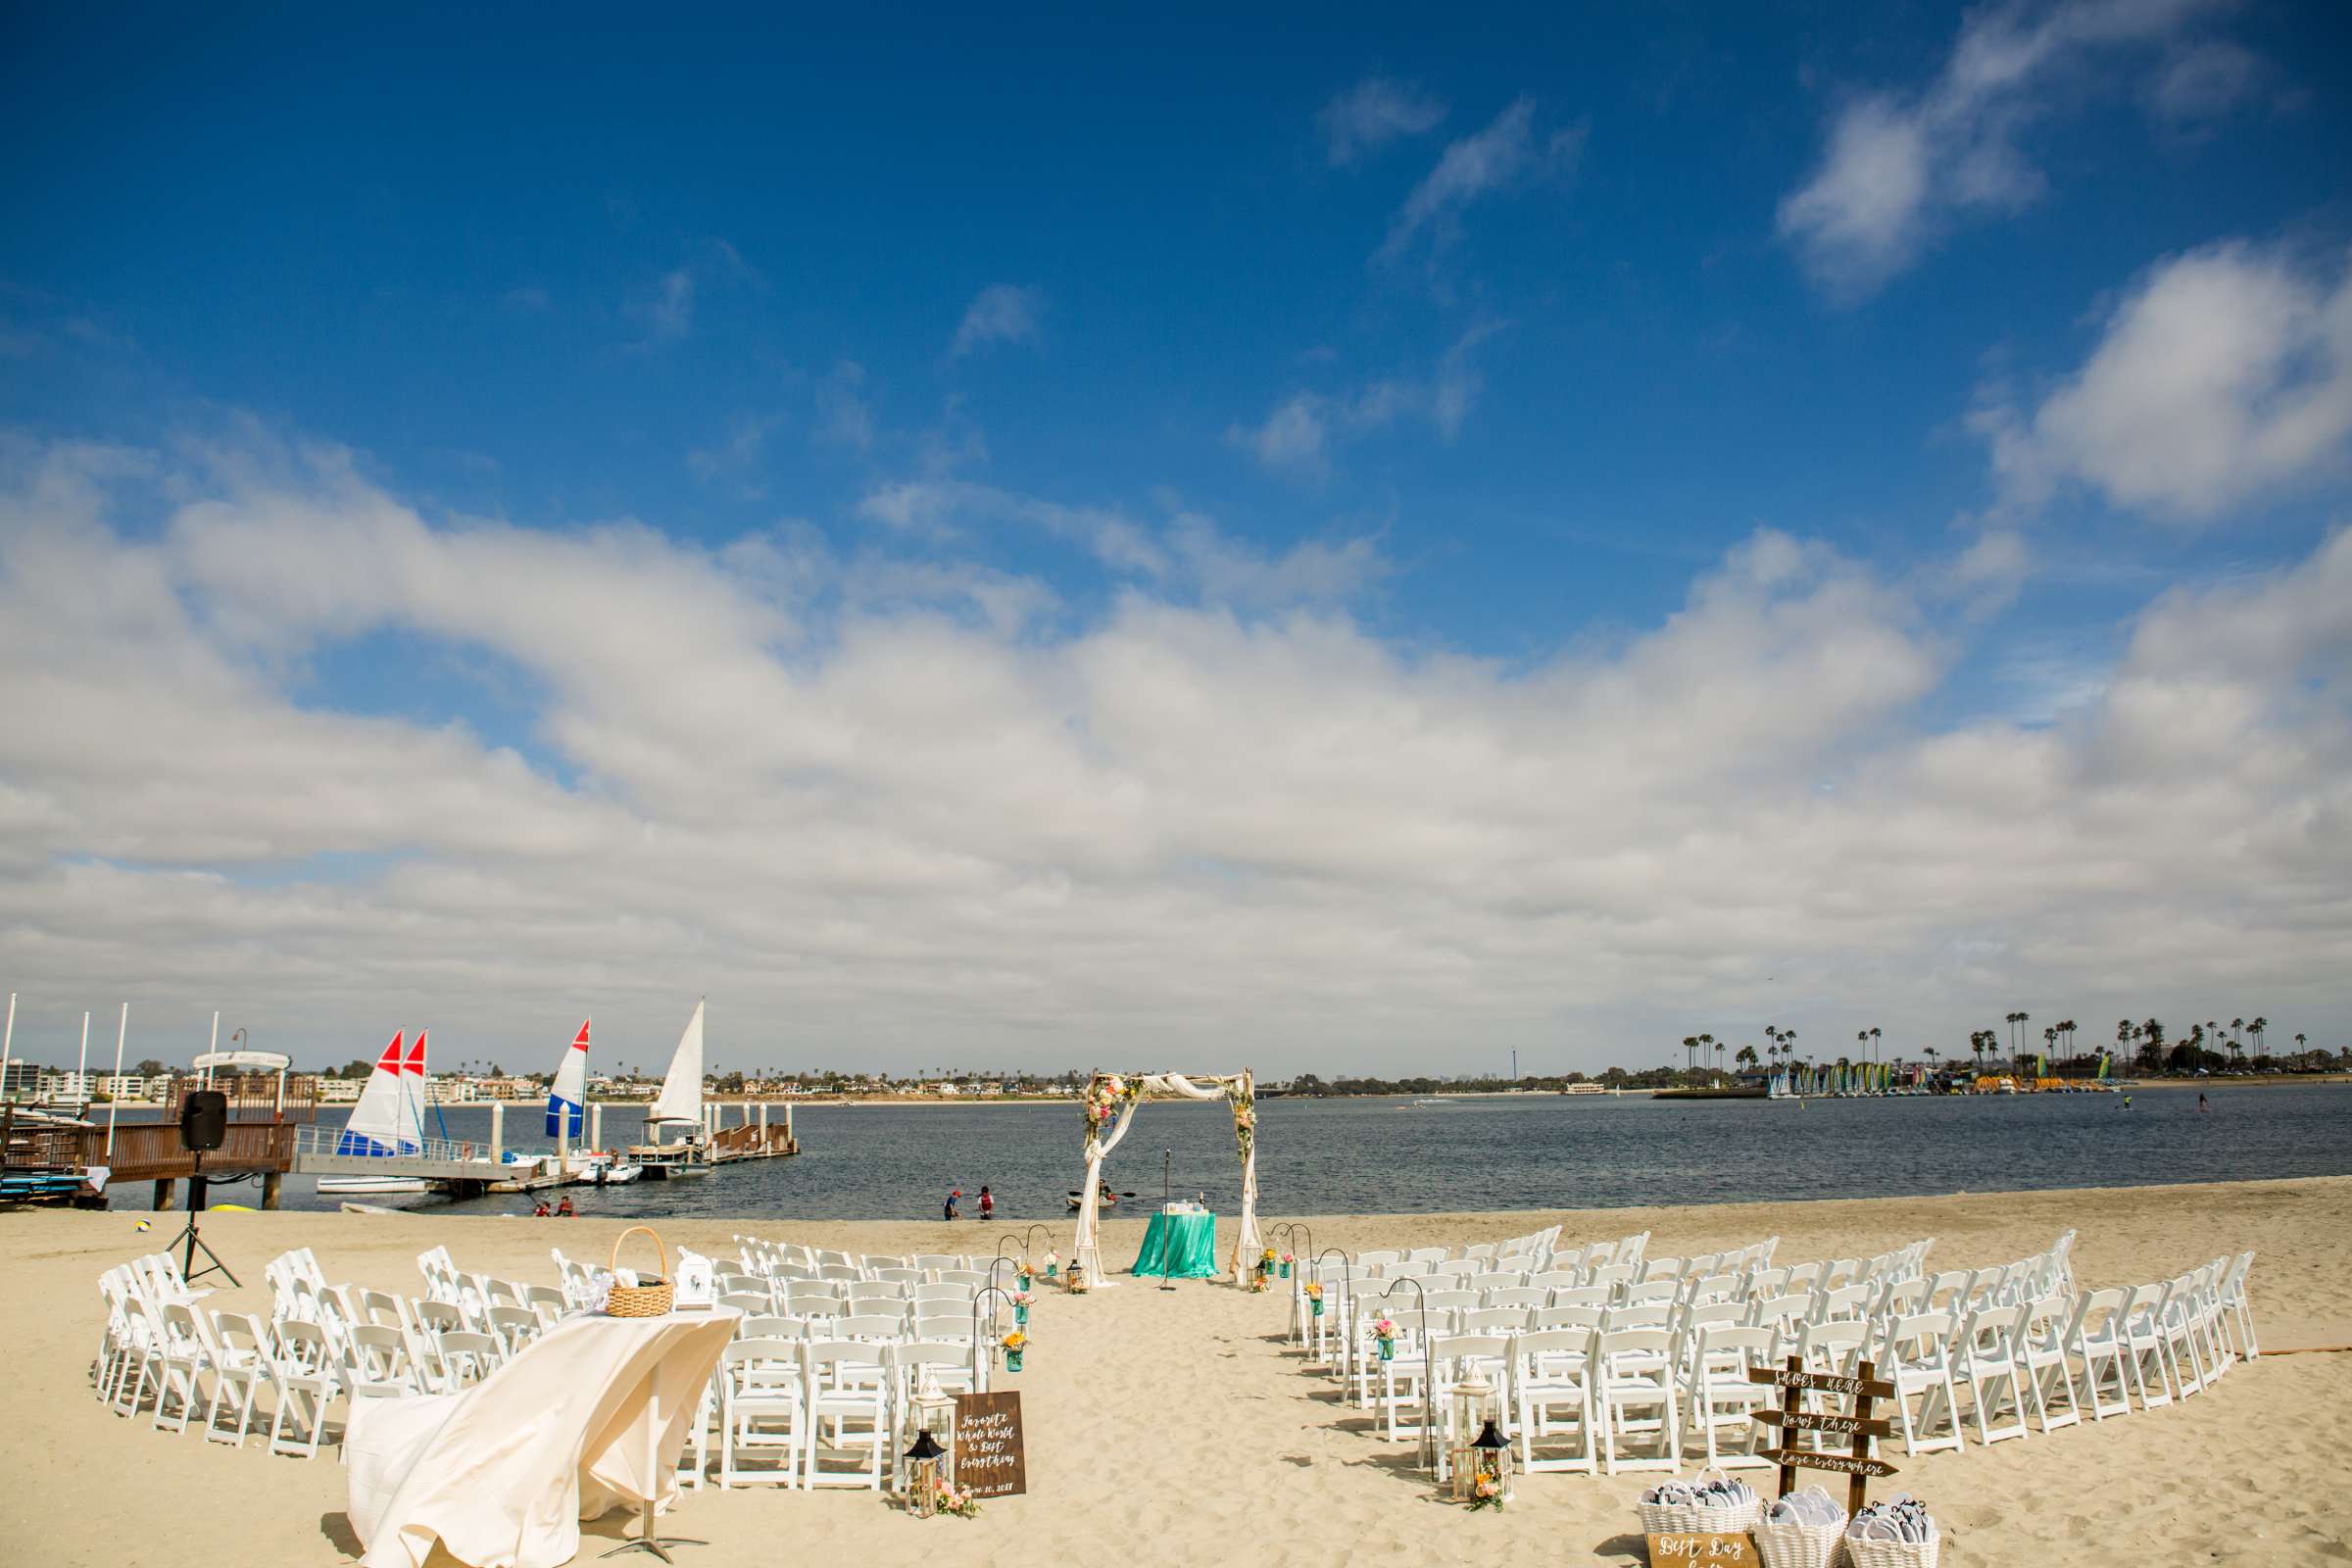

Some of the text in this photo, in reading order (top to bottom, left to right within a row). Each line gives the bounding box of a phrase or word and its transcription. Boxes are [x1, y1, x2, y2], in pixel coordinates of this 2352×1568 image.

[1774, 1371, 1864, 1394] SHOES HERE
[961, 1412, 1008, 1428] Favorite
[1782, 1411, 1862, 1433] Vows there
[956, 1426, 1015, 1442] Whole World
[981, 1441, 1004, 1452] Best
[960, 1453, 1015, 1469] Everything
[1778, 1450, 1884, 1475] Love everywhere
[1658, 1537, 1744, 1560] Best Day
